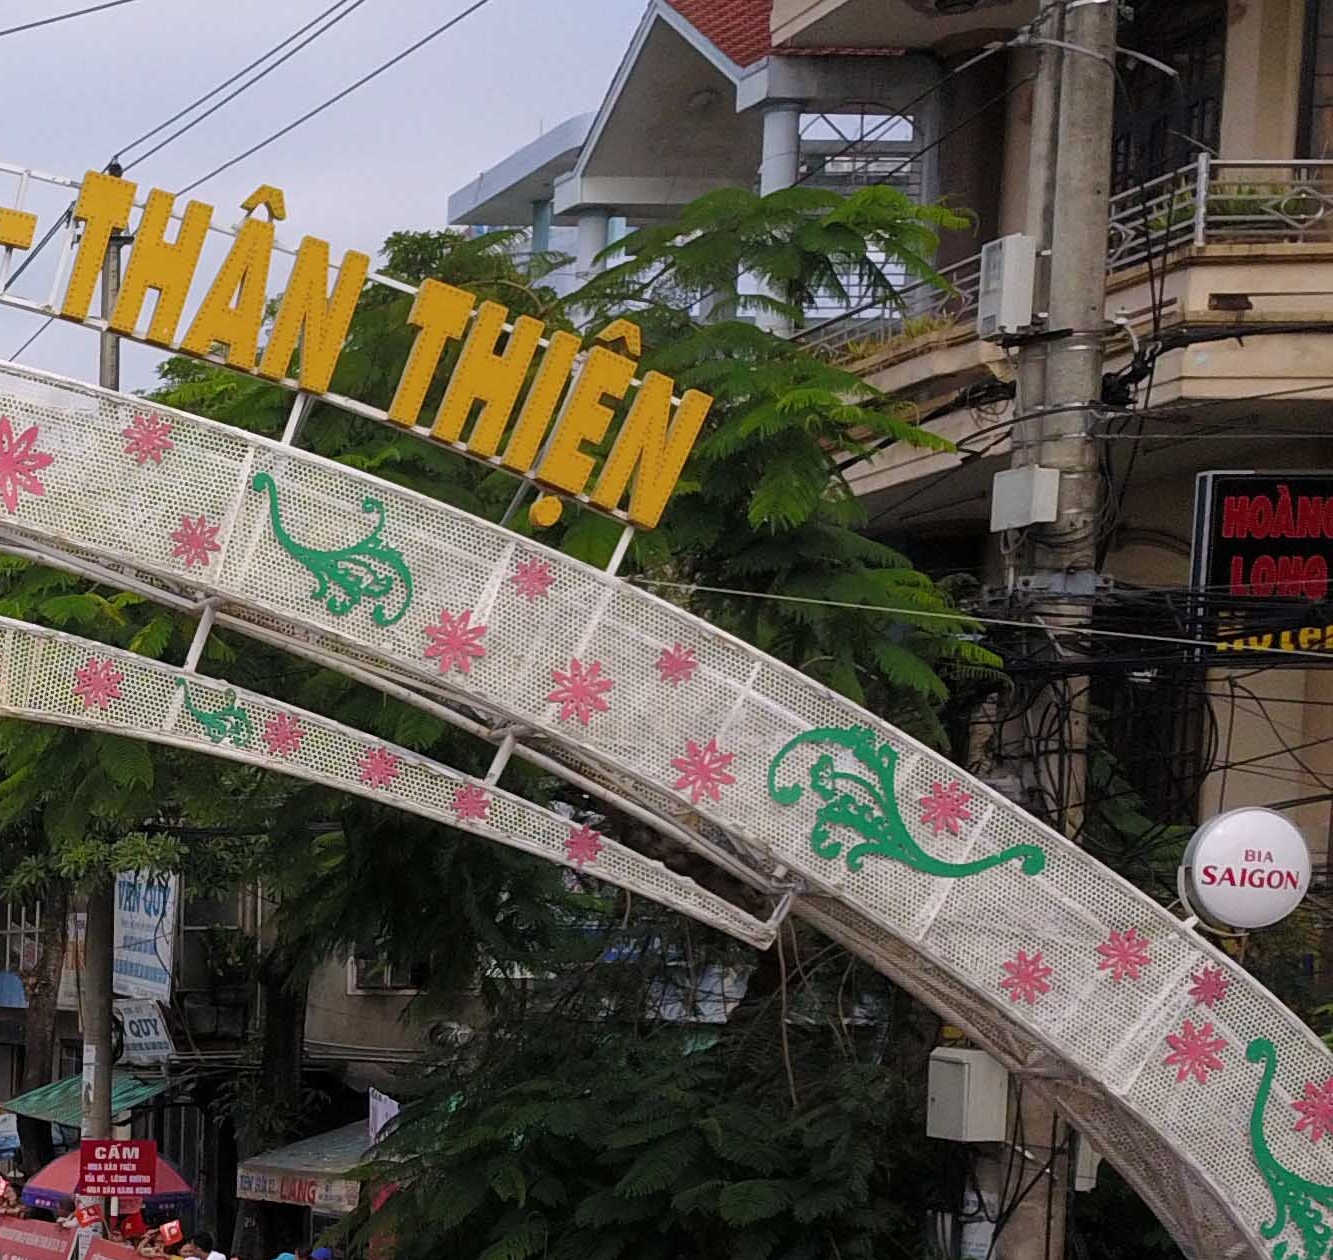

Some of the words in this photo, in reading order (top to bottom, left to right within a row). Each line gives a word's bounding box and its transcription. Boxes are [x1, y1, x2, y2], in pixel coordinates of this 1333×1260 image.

[60, 170, 371, 394] THÂN
[387, 277, 713, 531] THIỆN
[1229, 554, 1328, 599] LONG
[1244, 848, 1274, 863] BIA
[1201, 865, 1302, 891] SAIGON
[94, 1143, 140, 1160] CẤM
